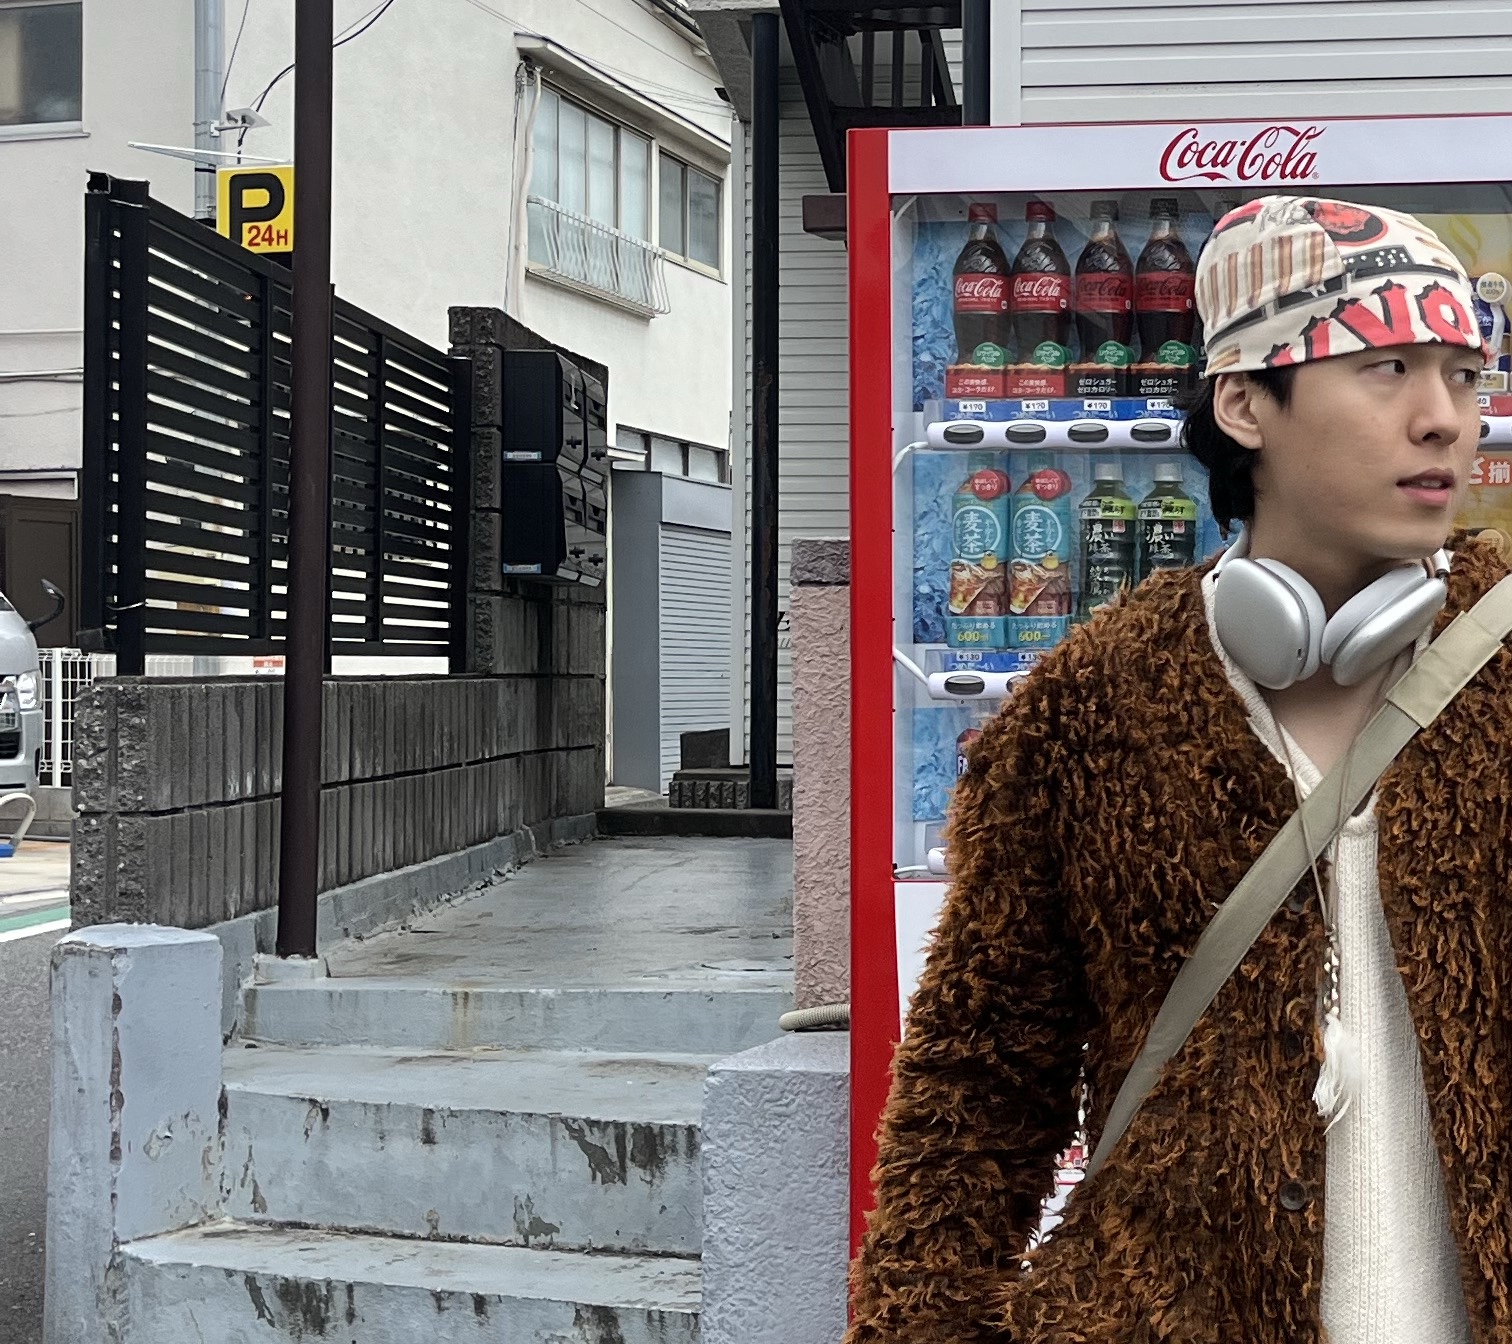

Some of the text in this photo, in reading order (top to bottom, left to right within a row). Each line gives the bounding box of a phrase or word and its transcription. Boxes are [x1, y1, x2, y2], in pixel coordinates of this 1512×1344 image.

[1160, 125, 1327, 182] Coca-Cola
[229, 172, 285, 246] P
[247, 224, 288, 247] 24H
[961, 511, 982, 553] 麦茶
[1023, 511, 1043, 553] 麦茶
